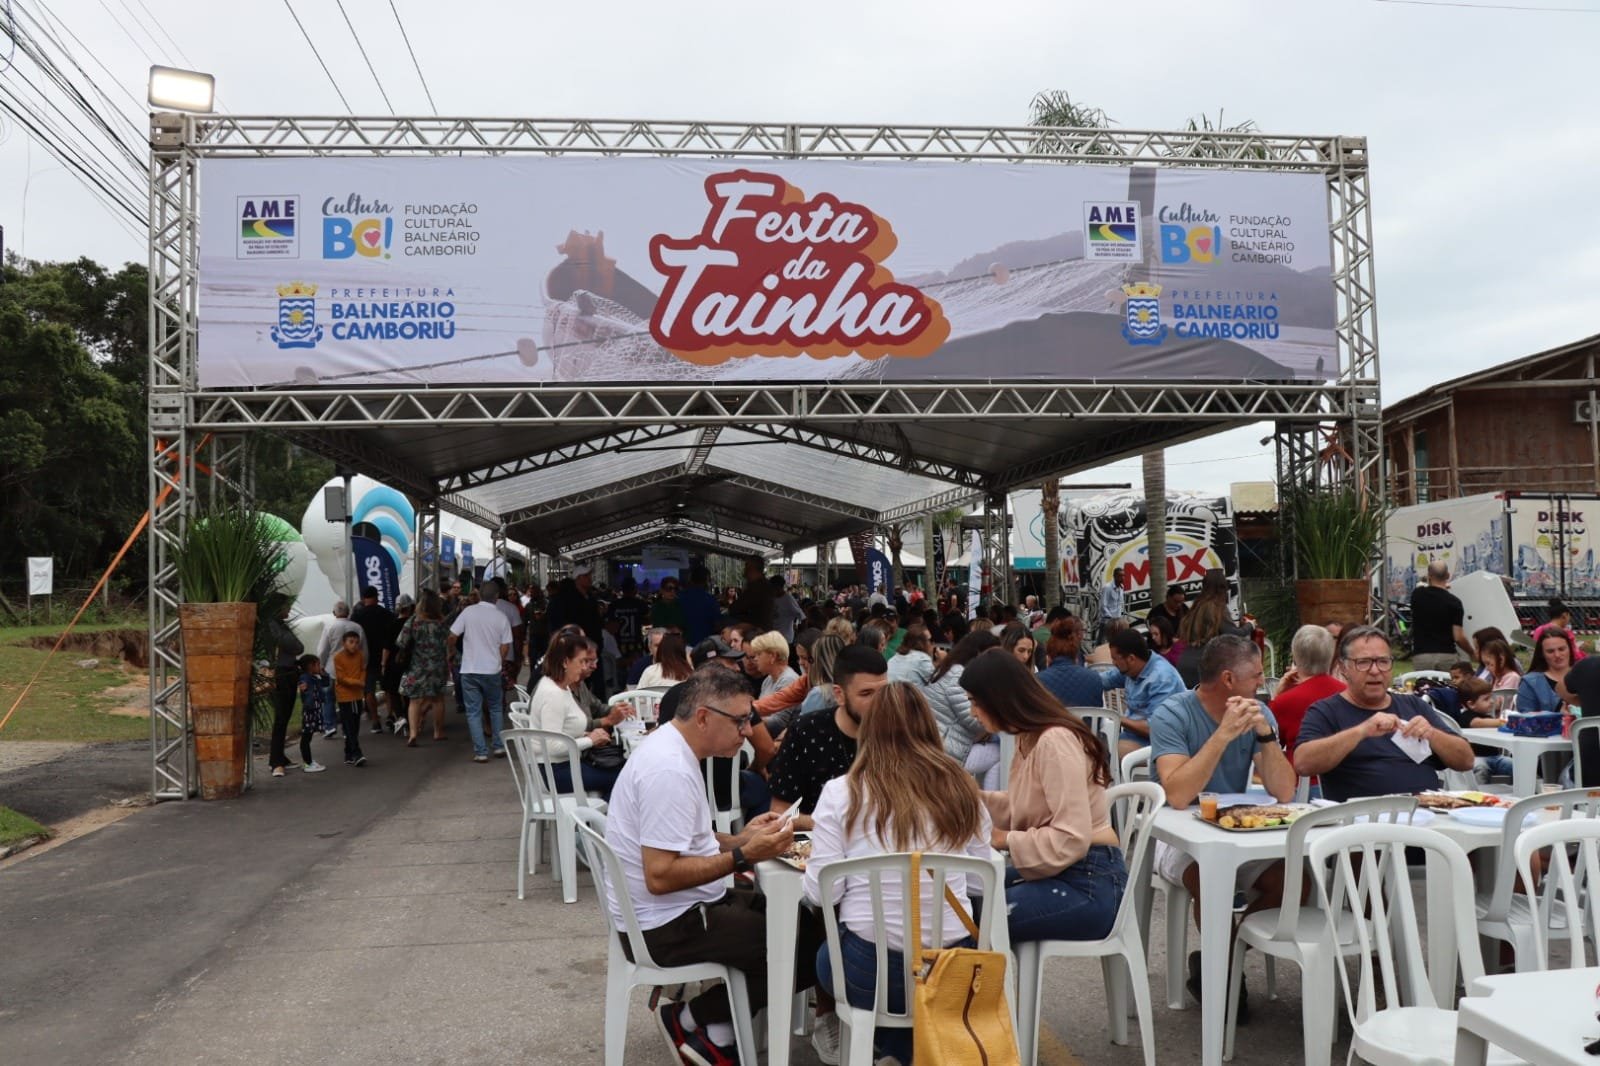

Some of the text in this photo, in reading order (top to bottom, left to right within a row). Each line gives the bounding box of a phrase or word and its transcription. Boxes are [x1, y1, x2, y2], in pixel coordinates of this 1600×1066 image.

[242, 200, 295, 218] AME
[321, 192, 394, 216] Cultura
[404, 202, 478, 216] FUNDAÇÃO
[711, 179, 868, 244] Festa
[1088, 206, 1136, 223] AME
[1158, 202, 1221, 224] Cultura
[1229, 215, 1292, 228] FUNDAÇÃO
[404, 218, 473, 229] CULTURAL
[404, 229, 480, 243] BALNEÁRIO
[1230, 228, 1287, 239] CULTURAL
[404, 242, 477, 257] CAMBORIÚ
[1231, 239, 1295, 252] BALNEÁRIO
[782, 246, 830, 281] da
[1232, 252, 1292, 265] CAMBORIÚ
[331, 288, 455, 298] PREFEITURA
[658, 244, 922, 339] Tainha
[1171, 290, 1278, 301] PREFEITURA
[331, 299, 455, 320] BALNEÁRIO
[1173, 303, 1278, 320] BALNEÁRIO
[331, 320, 455, 340] CAMBORIÚ
[1174, 321, 1280, 340] CAMBORIÚ
[1537, 511, 1584, 522] DISK
[1417, 520, 1453, 538] DISK
[1122, 547, 1208, 591] MIX
[1131, 591, 1152, 601] 10
